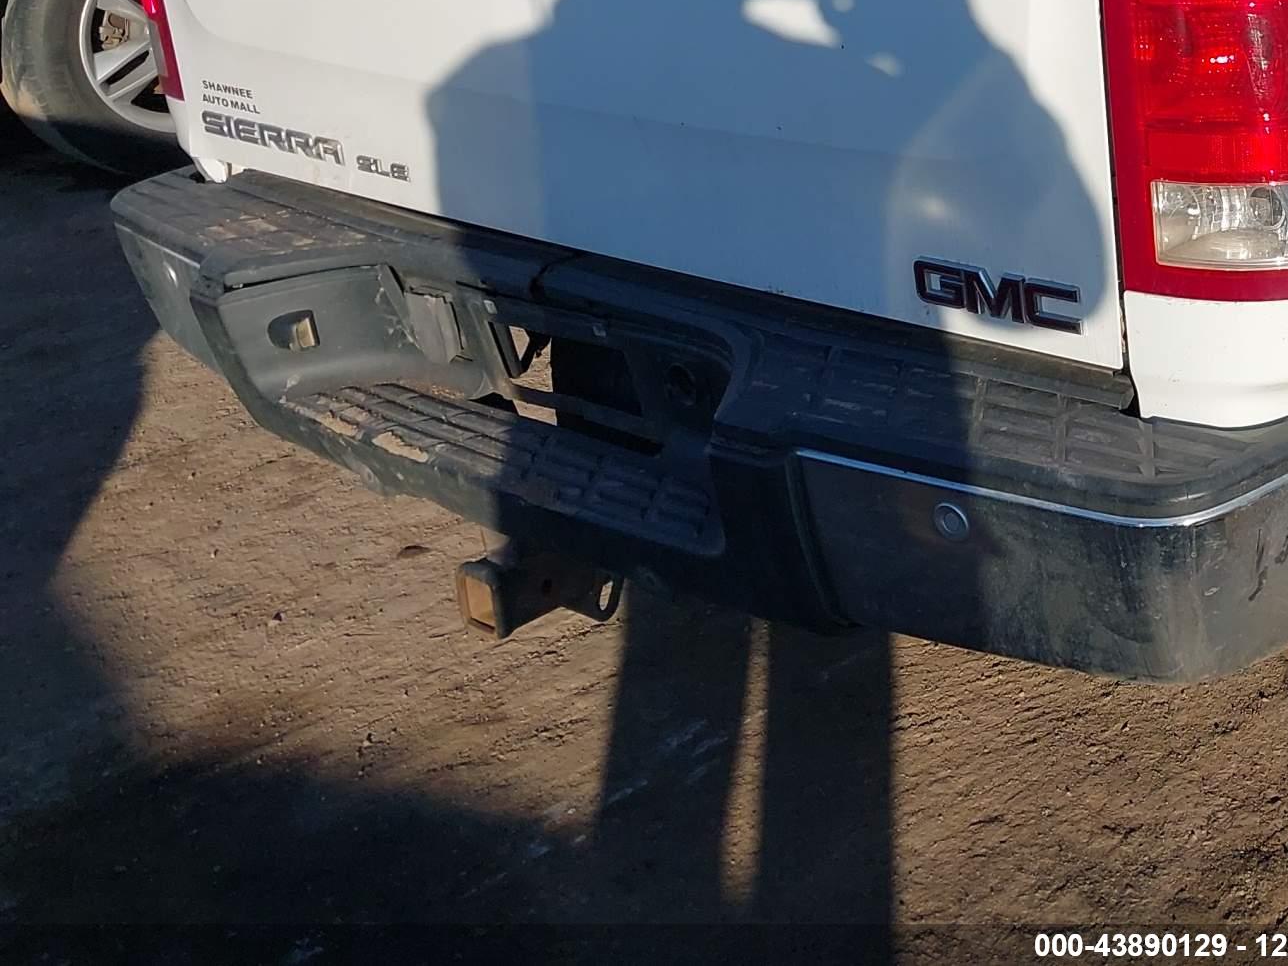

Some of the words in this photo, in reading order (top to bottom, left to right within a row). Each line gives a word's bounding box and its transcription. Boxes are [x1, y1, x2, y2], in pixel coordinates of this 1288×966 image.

[202, 80, 253, 99] SHAWNEE
[202, 94, 229, 107] AUTO
[230, 100, 260, 114] MALL
[202, 110, 345, 166] SIERRA
[356, 155, 411, 182] SLE
[913, 255, 1084, 335] GMC
